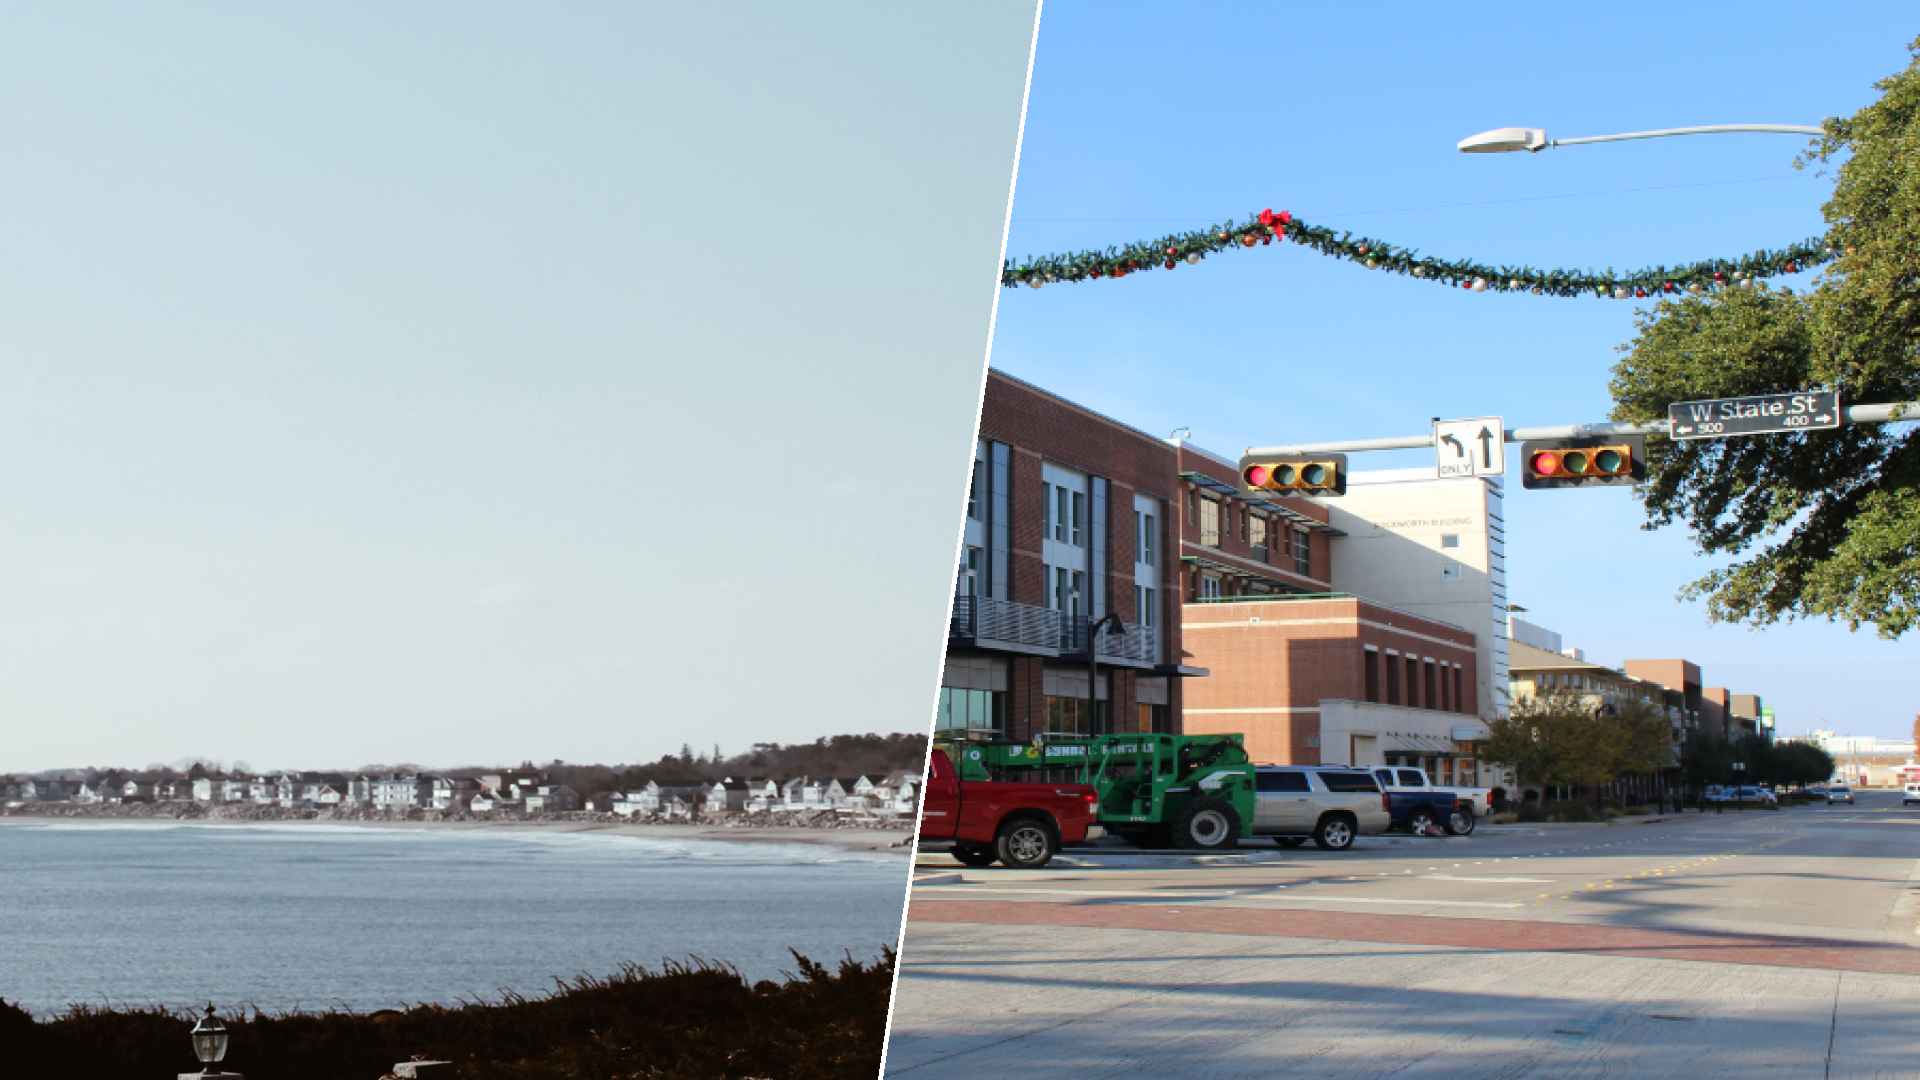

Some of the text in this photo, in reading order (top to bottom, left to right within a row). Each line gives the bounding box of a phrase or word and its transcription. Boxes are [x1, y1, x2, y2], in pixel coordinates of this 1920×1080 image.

[1690, 395, 1817, 422] W State St
[1783, 415, 1809, 427] 400
[1440, 463, 1472, 474] ONLY
